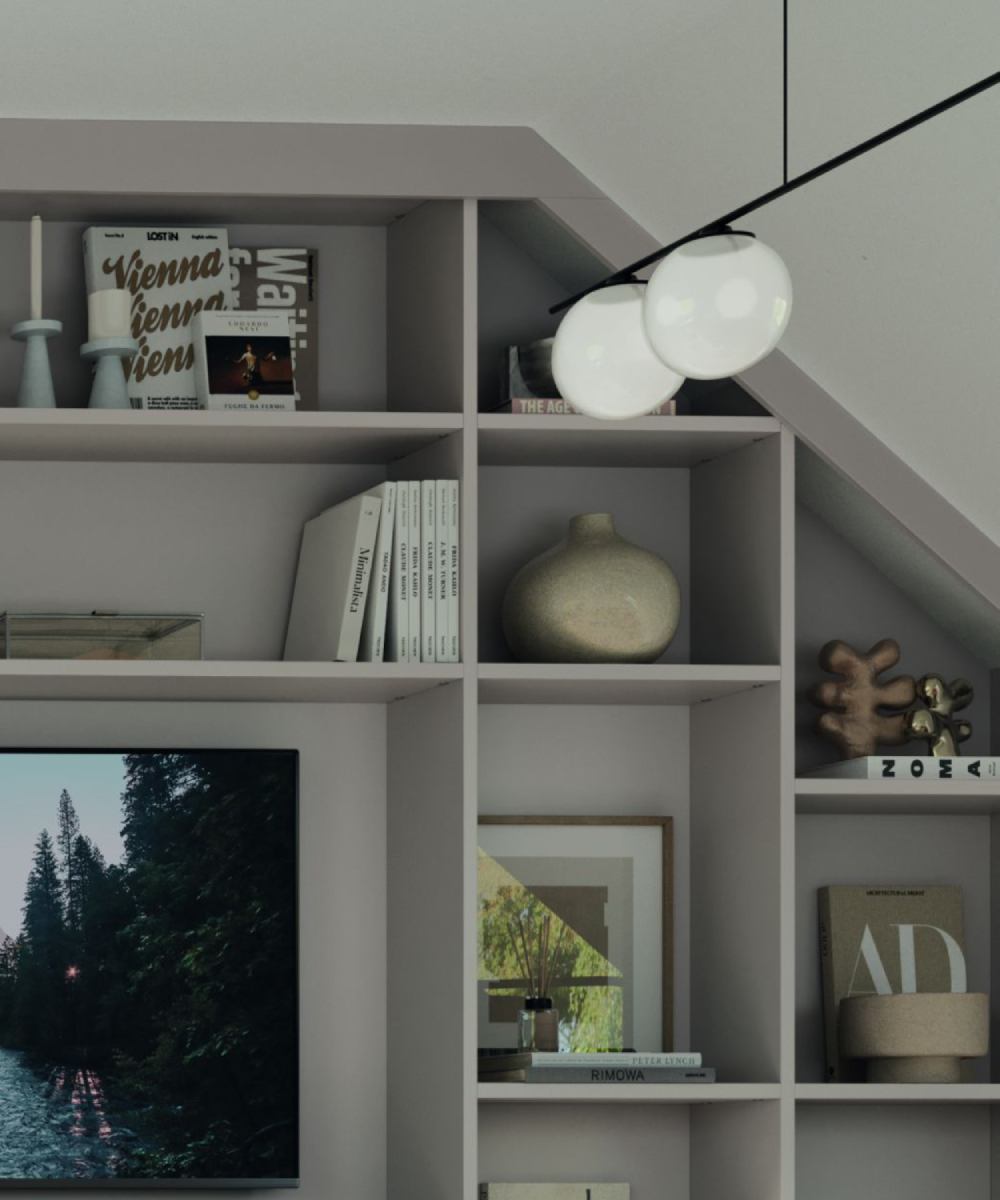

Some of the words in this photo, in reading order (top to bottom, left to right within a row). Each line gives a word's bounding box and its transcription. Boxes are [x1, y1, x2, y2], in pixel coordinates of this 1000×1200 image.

[147, 232, 167, 240] LOST
[102, 248, 224, 296] Vienna
[520, 400, 544, 413] THE
[547, 400, 571, 413] AGE
[441, 549, 445, 557] M.
[441, 560, 445, 568] W.
[349, 547, 370, 613] Minimalista
[847, 923, 967, 996] AD
[632, 1057, 661, 1065] PETER
[664, 1057, 695, 1065] LYNCH
[591, 1070, 644, 1081] RIMOWA
